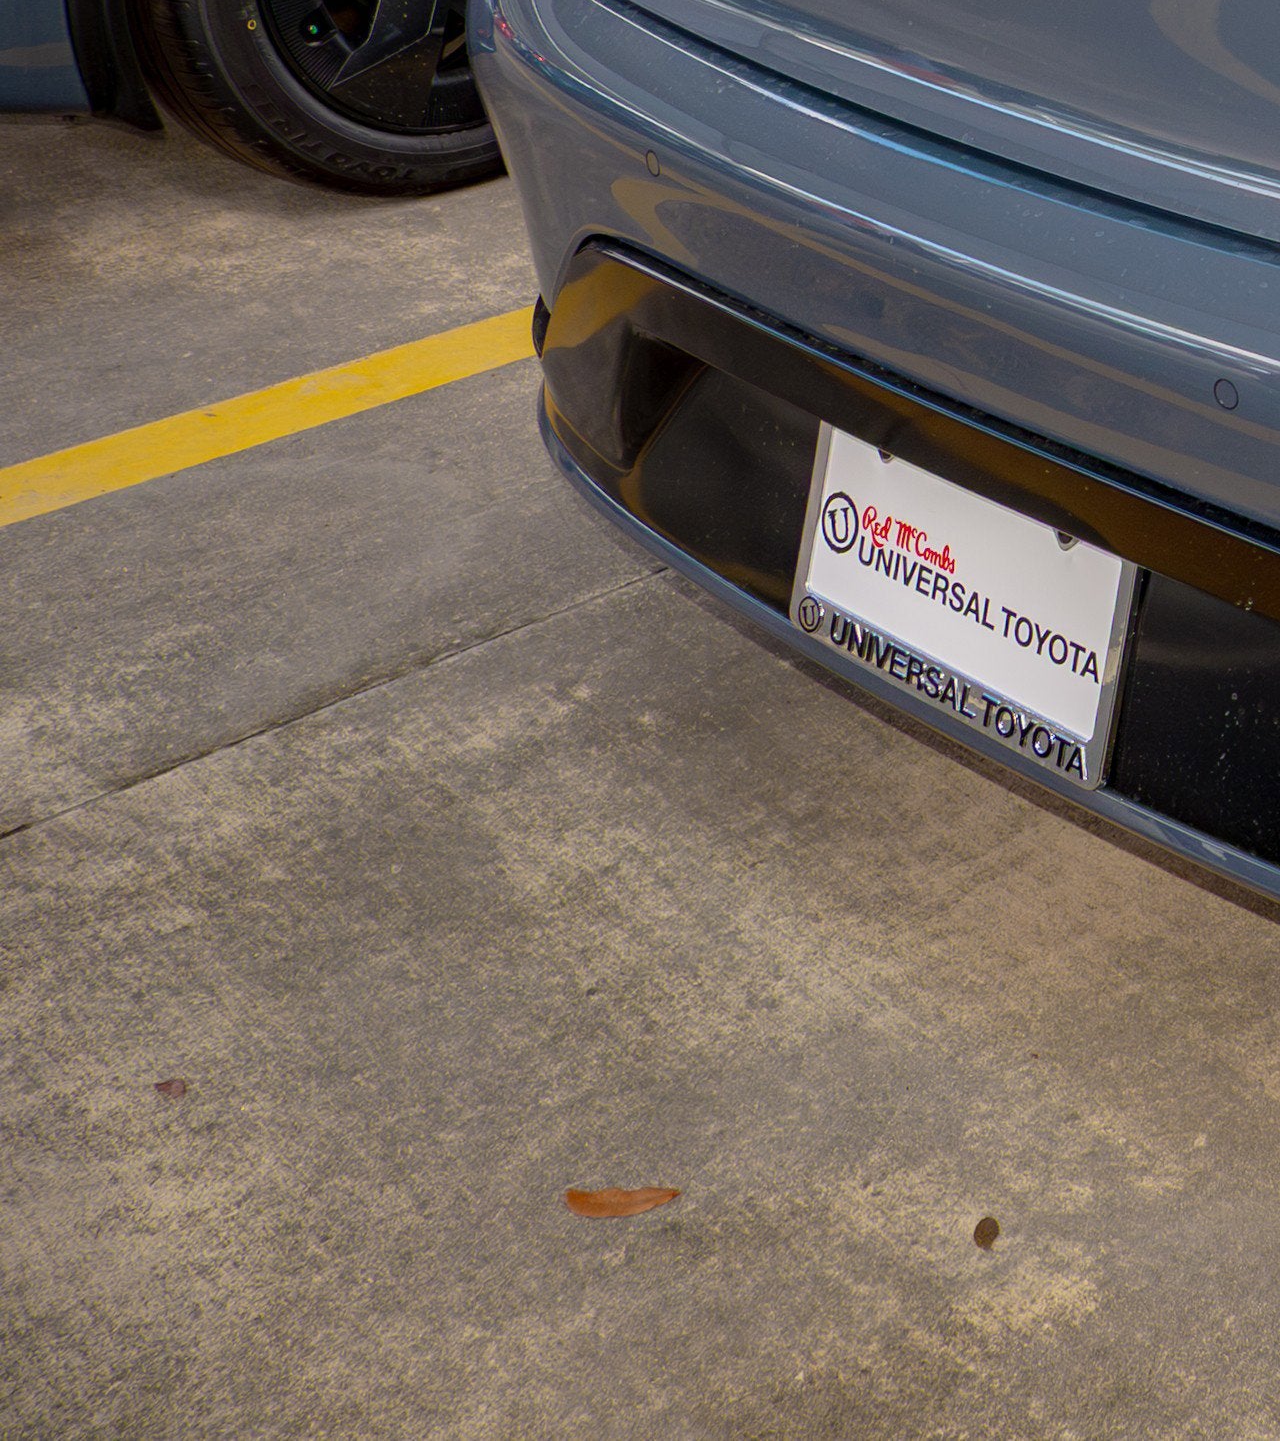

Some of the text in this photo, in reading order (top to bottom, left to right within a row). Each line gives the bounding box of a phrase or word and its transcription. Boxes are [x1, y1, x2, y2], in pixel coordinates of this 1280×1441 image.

[862, 505, 893, 548] Red
[858, 535, 1100, 684] UNIVERSAL TOYOTA
[831, 611, 1088, 780] UNIVERSAL TOYOTA
